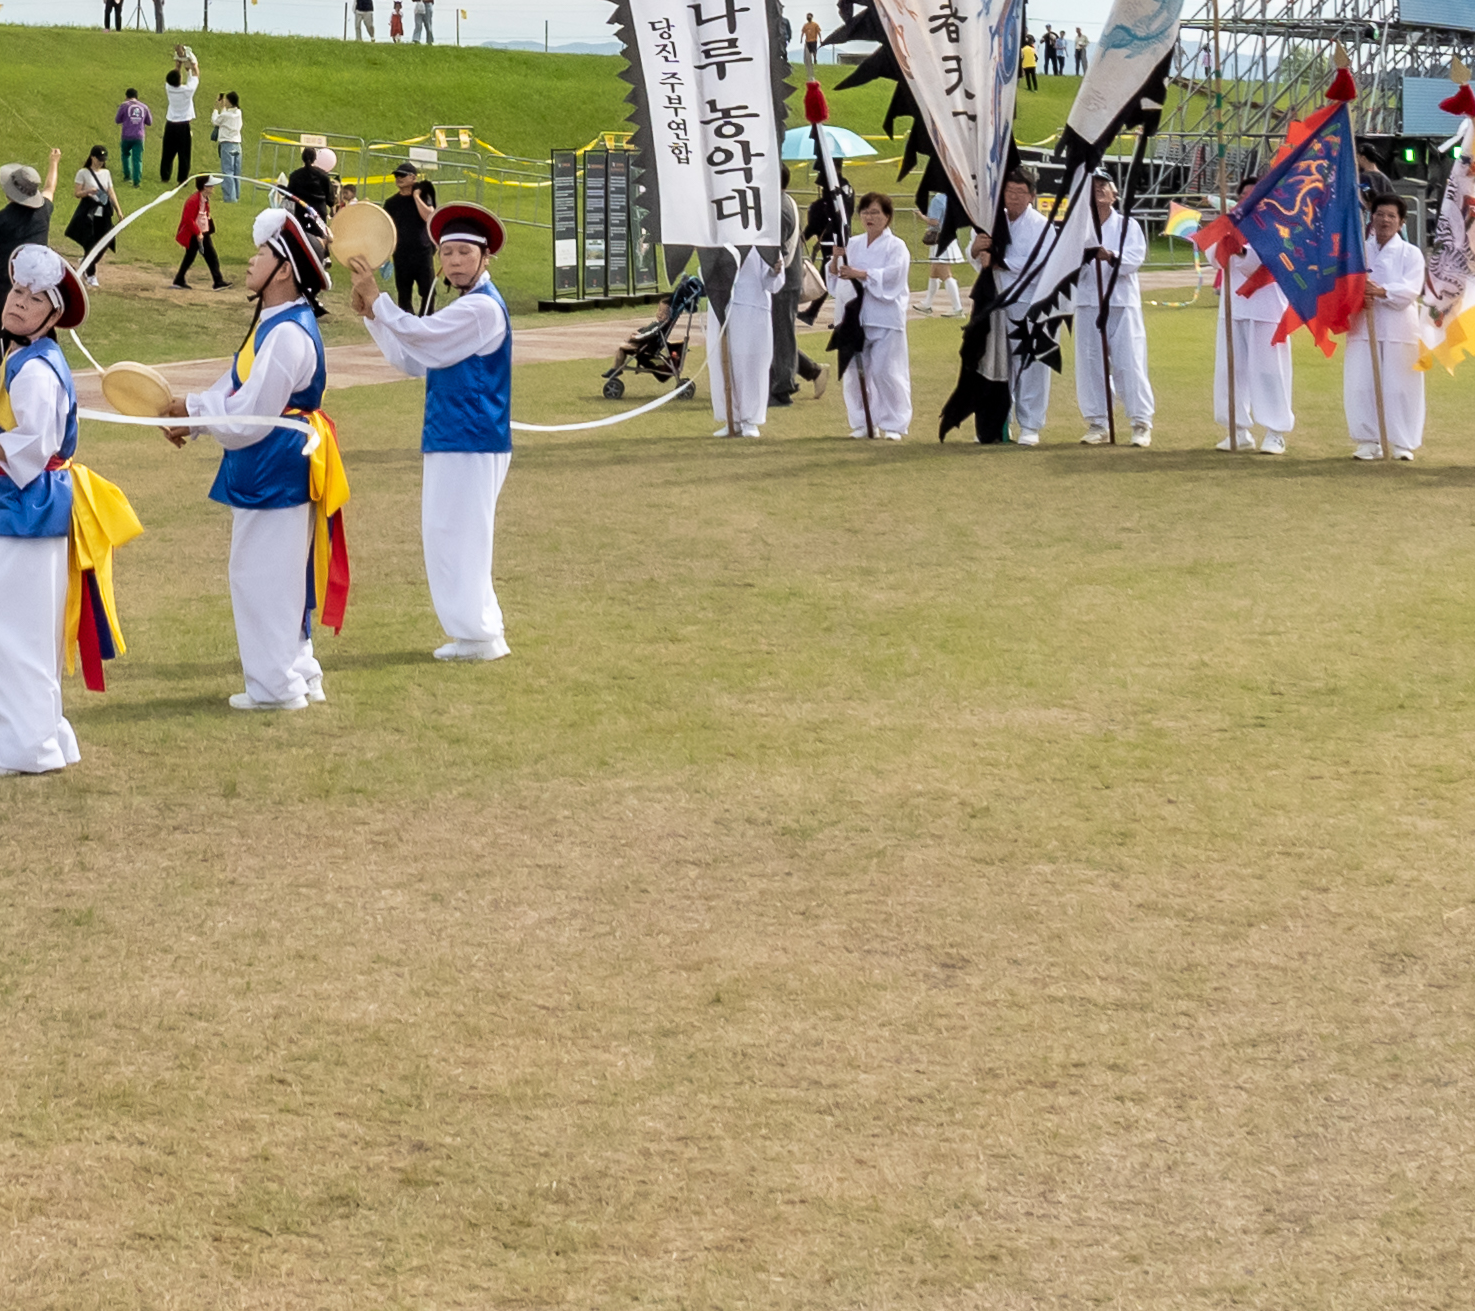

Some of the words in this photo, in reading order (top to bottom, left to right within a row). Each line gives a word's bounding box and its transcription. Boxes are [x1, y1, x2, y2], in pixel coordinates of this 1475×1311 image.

[648, 18, 680, 62] 당진
[659, 72, 692, 165] 주부연합
[700, 99, 765, 231] 농악대
